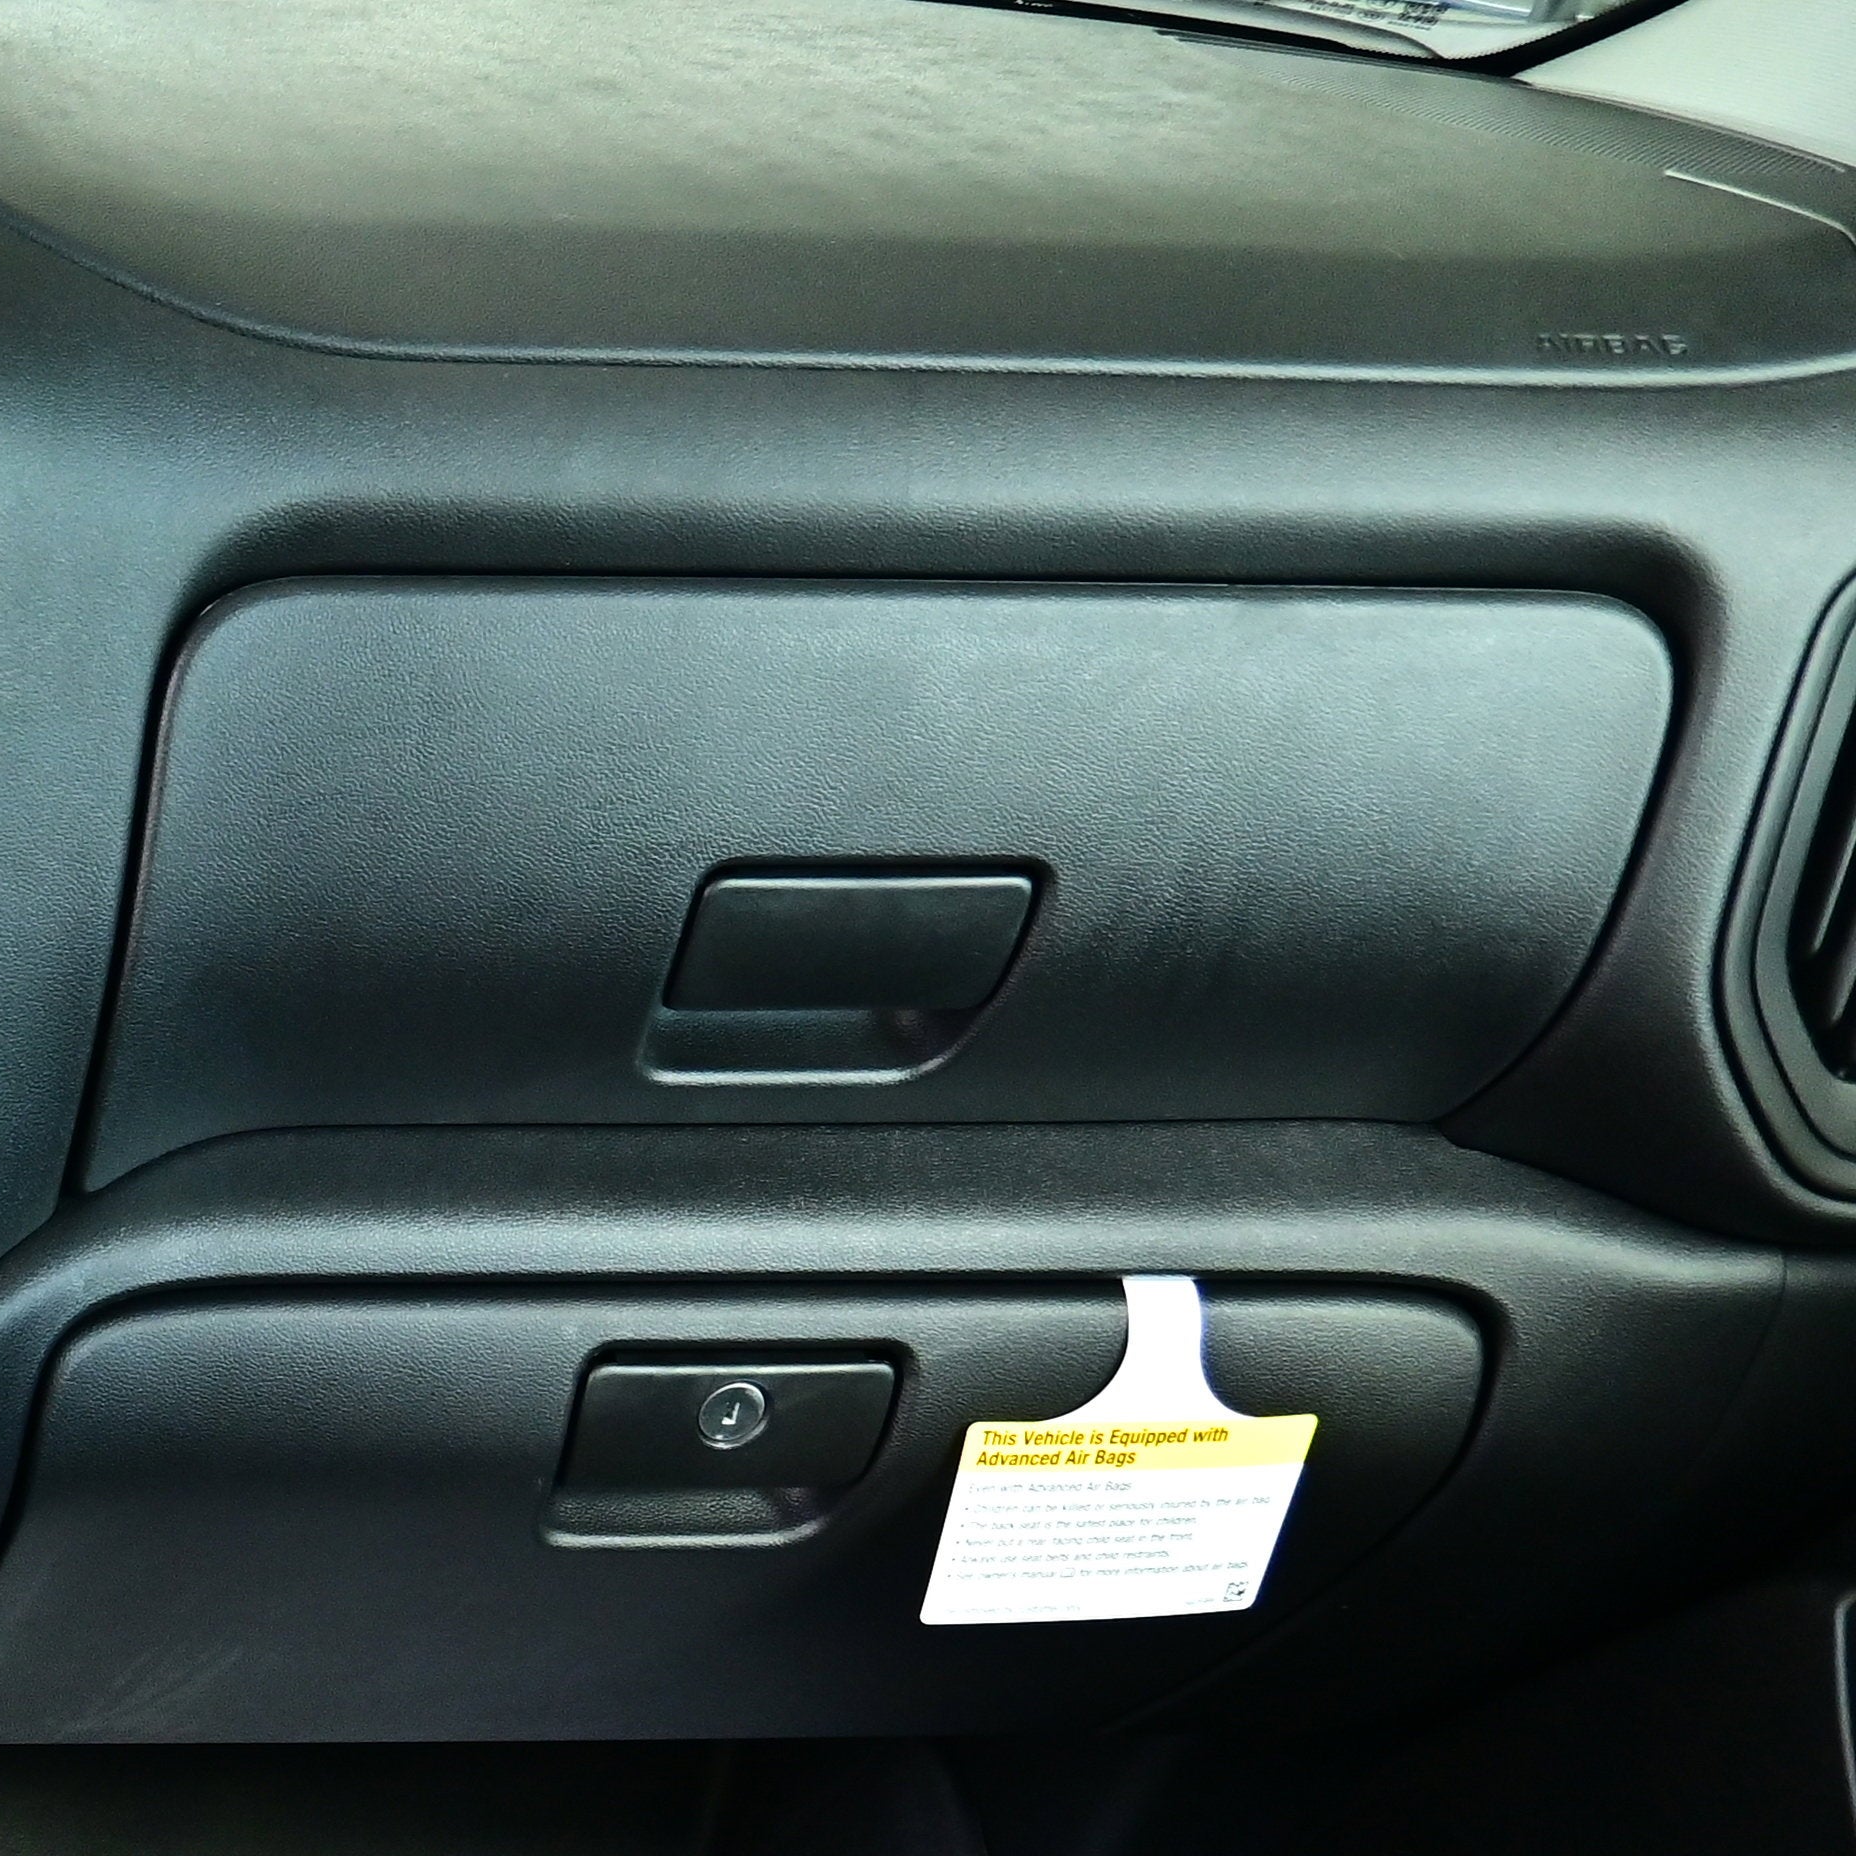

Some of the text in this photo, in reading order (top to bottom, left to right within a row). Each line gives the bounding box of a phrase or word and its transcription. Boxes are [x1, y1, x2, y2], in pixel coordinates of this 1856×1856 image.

[983, 1427, 1229, 1447] This Vehicle is Equipped with
[976, 1449, 1137, 1469] Advanced Air Bags
